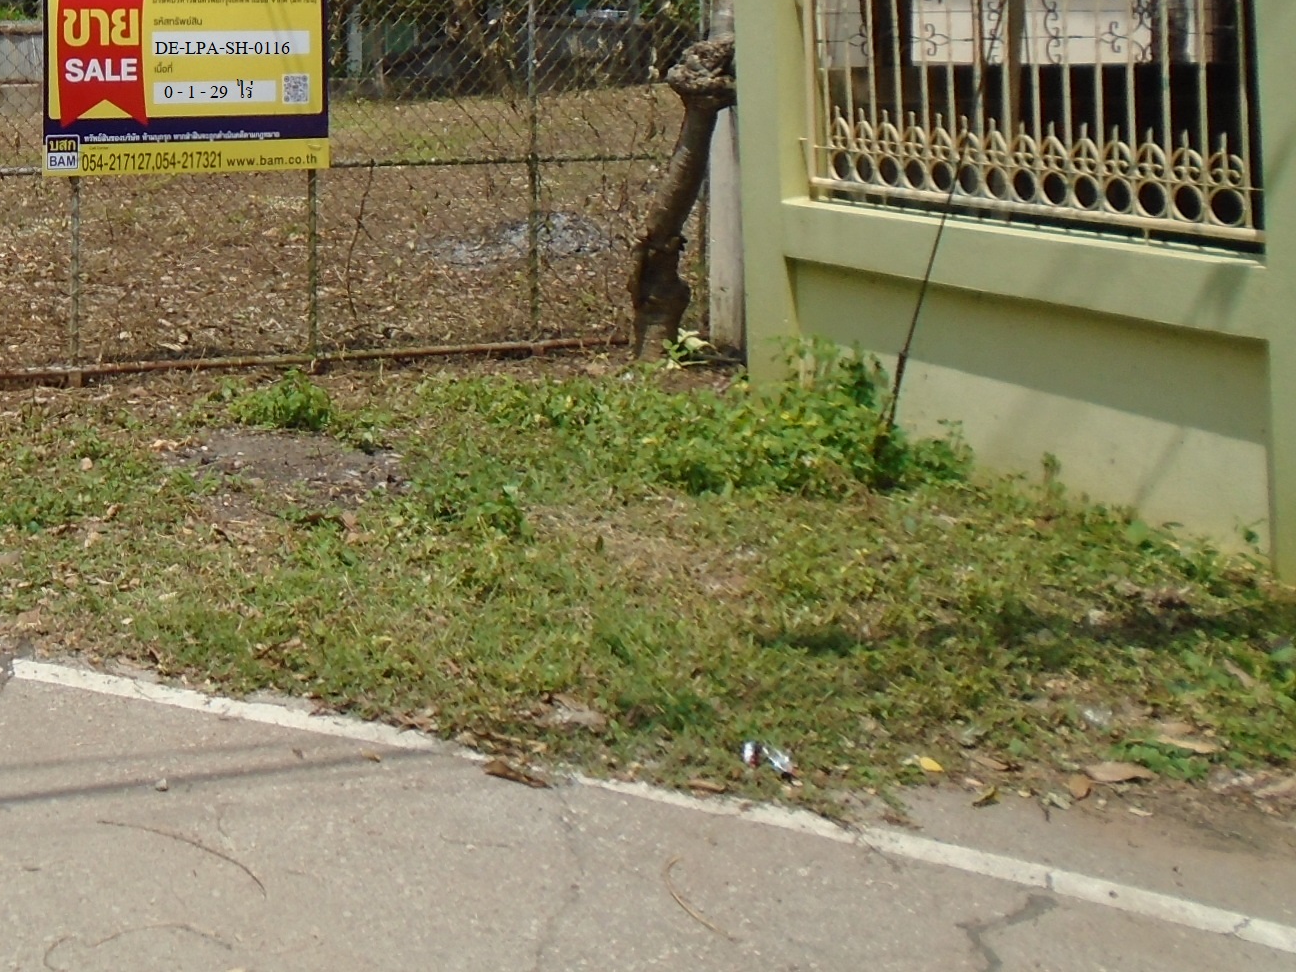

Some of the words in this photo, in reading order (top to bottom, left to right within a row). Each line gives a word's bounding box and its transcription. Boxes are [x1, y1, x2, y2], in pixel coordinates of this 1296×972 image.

[153, 16, 203, 26] รหัสทรัพย์สิน
[63, 8, 140, 47] ขาย
[65, 58, 138, 83] SALE
[154, 62, 173, 74] เนื้อที่
[49, 139, 76, 151] บสก
[49, 155, 76, 167] BAM
[82, 150, 222, 171] 054-217127,054-217321
[226, 154, 317, 167] www.bam.co.th
